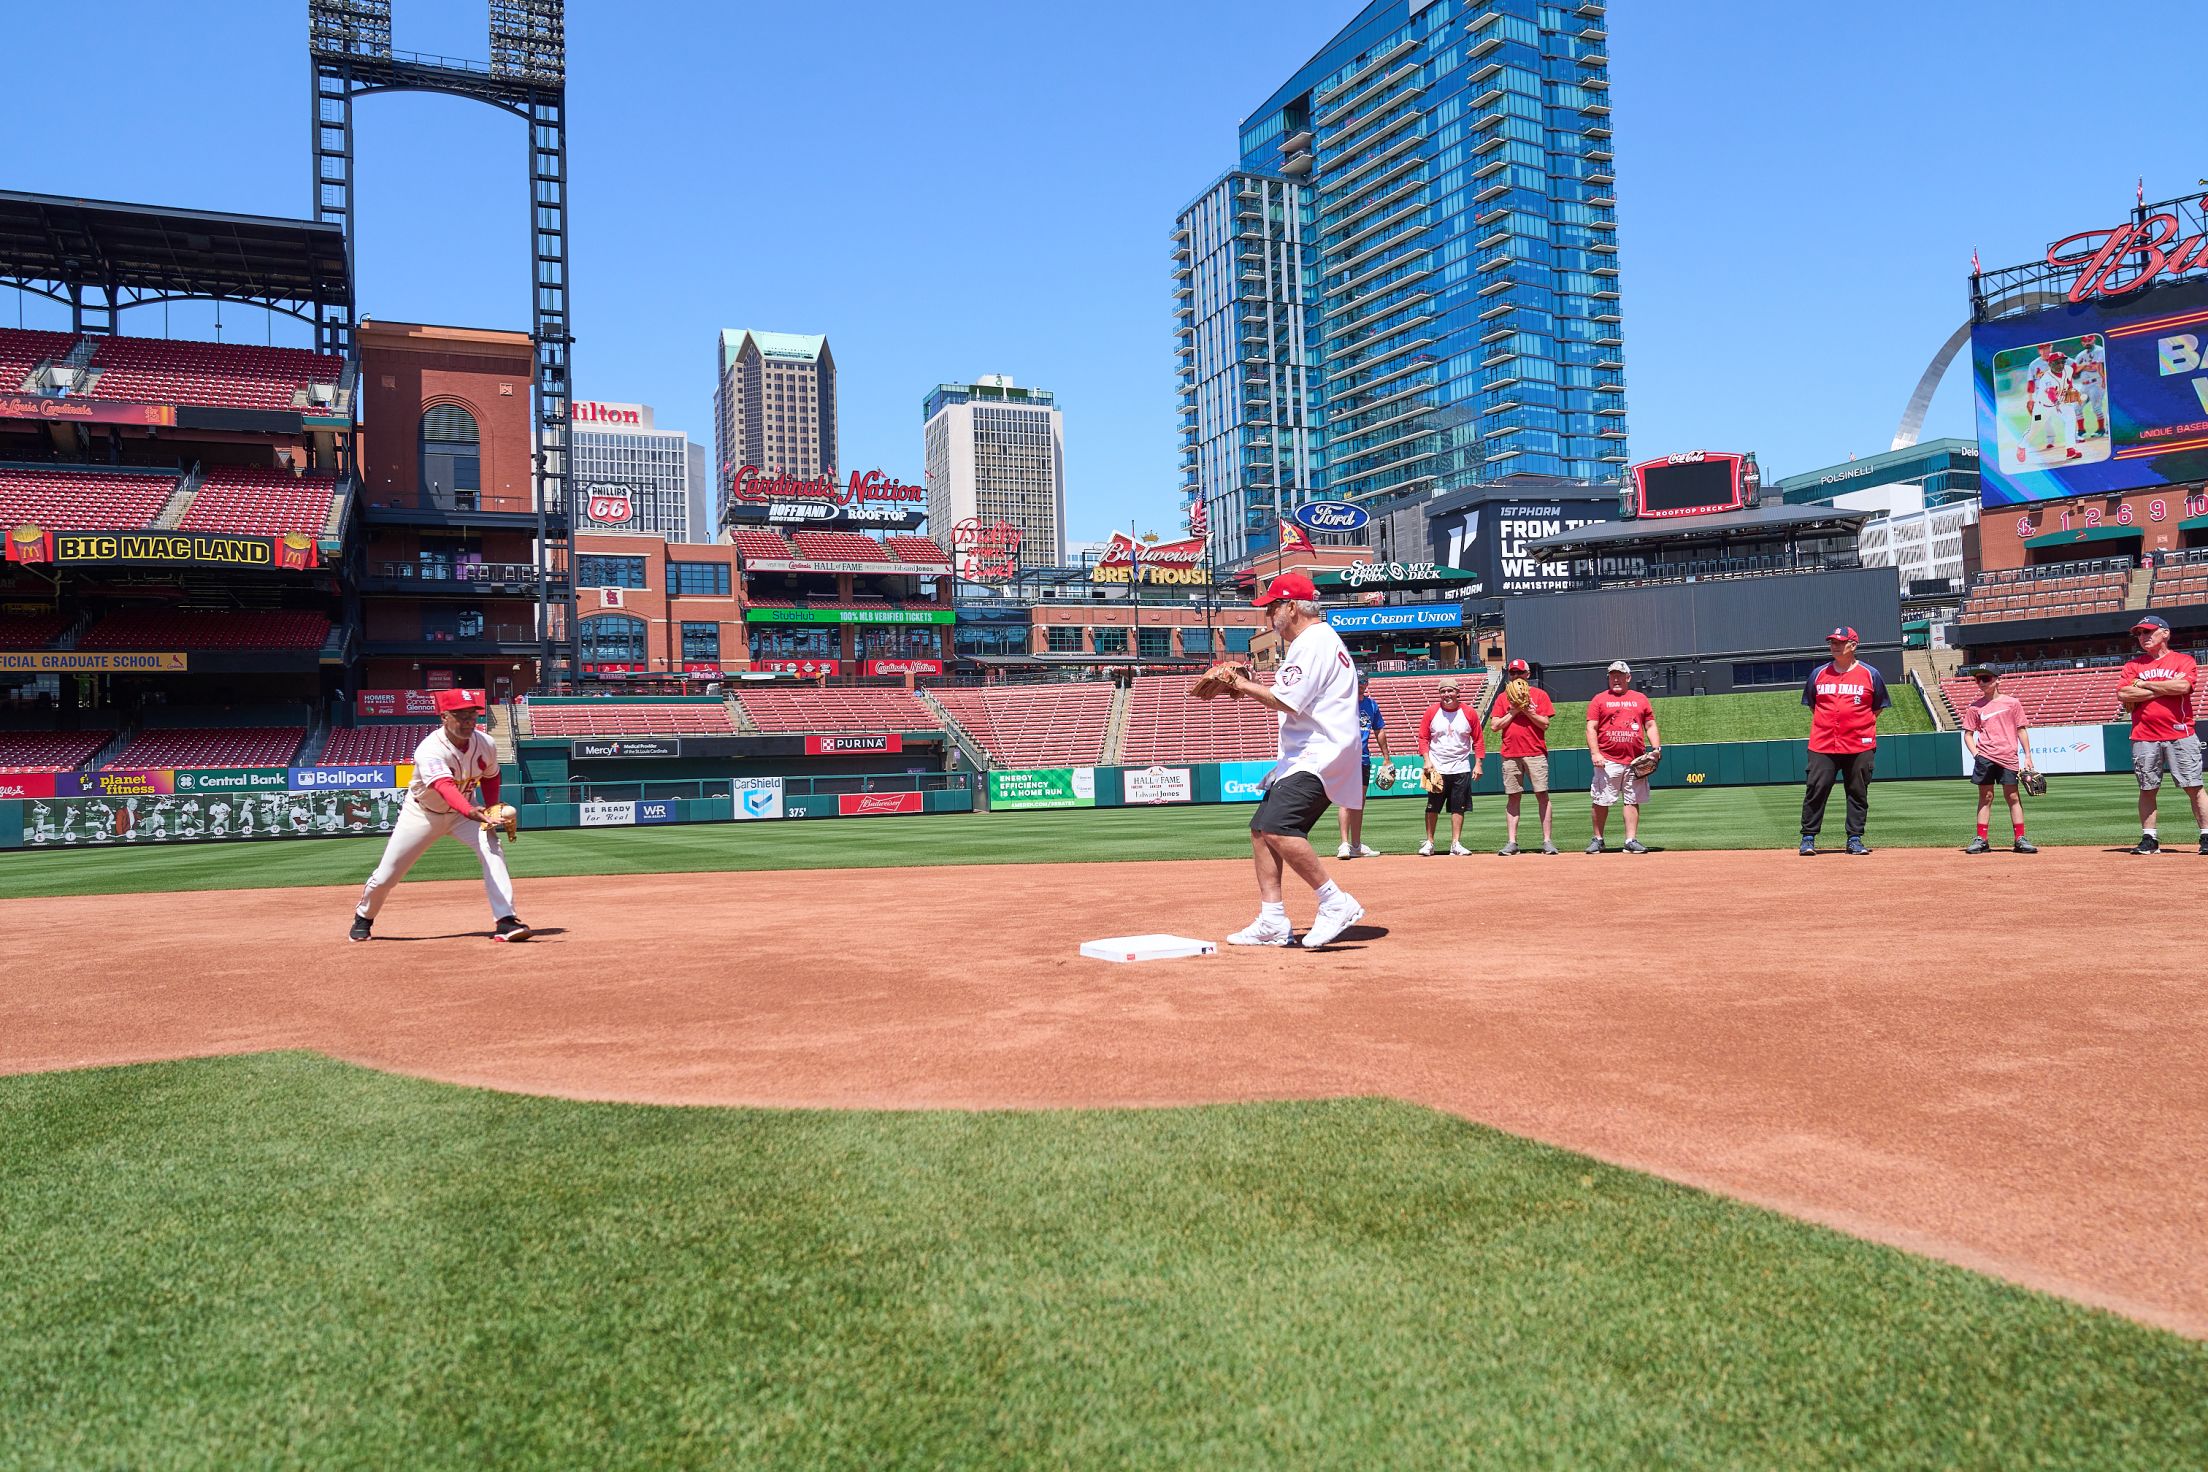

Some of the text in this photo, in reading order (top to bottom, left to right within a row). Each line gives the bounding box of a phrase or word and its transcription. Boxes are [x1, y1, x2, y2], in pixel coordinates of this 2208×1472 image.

[40, 399, 94, 417] Cardinals
[2140, 427, 2173, 439] UNIQUE
[1821, 464, 1874, 485] POLSINELLI
[733, 465, 922, 506] Cardinals Nation
[592, 487, 627, 498] PHILLIPS
[594, 499, 625, 517] 66
[768, 503, 828, 518] HOFFMANN
[2149, 499, 2166, 521] 9
[2184, 494, 2208, 518] 10
[847, 509, 908, 521] ROOFTOP
[1310, 504, 1356, 526] Ford
[1655, 508, 1697, 517] ROOFTOP
[2085, 508, 2101, 529] 2
[2116, 504, 2132, 525] 6
[2060, 512, 2070, 531] 1
[951, 517, 1024, 553] Bally
[1501, 520, 1560, 538] FROM
[58, 536, 270, 565] BIG MAC LAND
[967, 547, 1006, 558] SPORTS
[1095, 542, 1207, 564] Budweiser
[788, 560, 812, 570] Cardinals
[814, 562, 835, 571] HALL
[842, 563, 863, 571] FAME
[1351, 559, 1386, 572] SCOTT
[1407, 562, 1435, 572] MVP
[1093, 566, 1213, 585] BREW HOUSE
[1340, 567, 1381, 580] CREDIT
[1407, 570, 1441, 580] DECK
[1350, 574, 1388, 587] UNION
[772, 610, 932, 622] StubHub 100% MLB VERIFIED TICKETS
[1332, 610, 1457, 627] SCOTT CREDIT UNION
[42, 655, 109, 668] GRADUATE
[113, 655, 162, 668] SCHOOL
[2139, 668, 2176, 680] ARDINAL
[837, 738, 883, 749] PURINA
[586, 746, 613, 756] Mercy
[100, 774, 146, 786] planet
[199, 772, 286, 787] Central Bank
[316, 770, 384, 786] Ballpark
[734, 777, 781, 790] CarShield
[1133, 776, 1154, 784] HALL
[1160, 776, 1181, 784] FAME
[1686, 773, 1705, 783] 400'
[106, 783, 155, 795] fitness
[1000, 781, 1049, 789] EFFICIENCY
[1018, 789, 1043, 797] HOME
[1159, 790, 1180, 798] Jones
[601, 805, 631, 813] READY
[861, 799, 900, 809] Budweiser
[643, 805, 667, 816] WR
[788, 808, 806, 818] 375'
[586, 813, 629, 822] for Real
